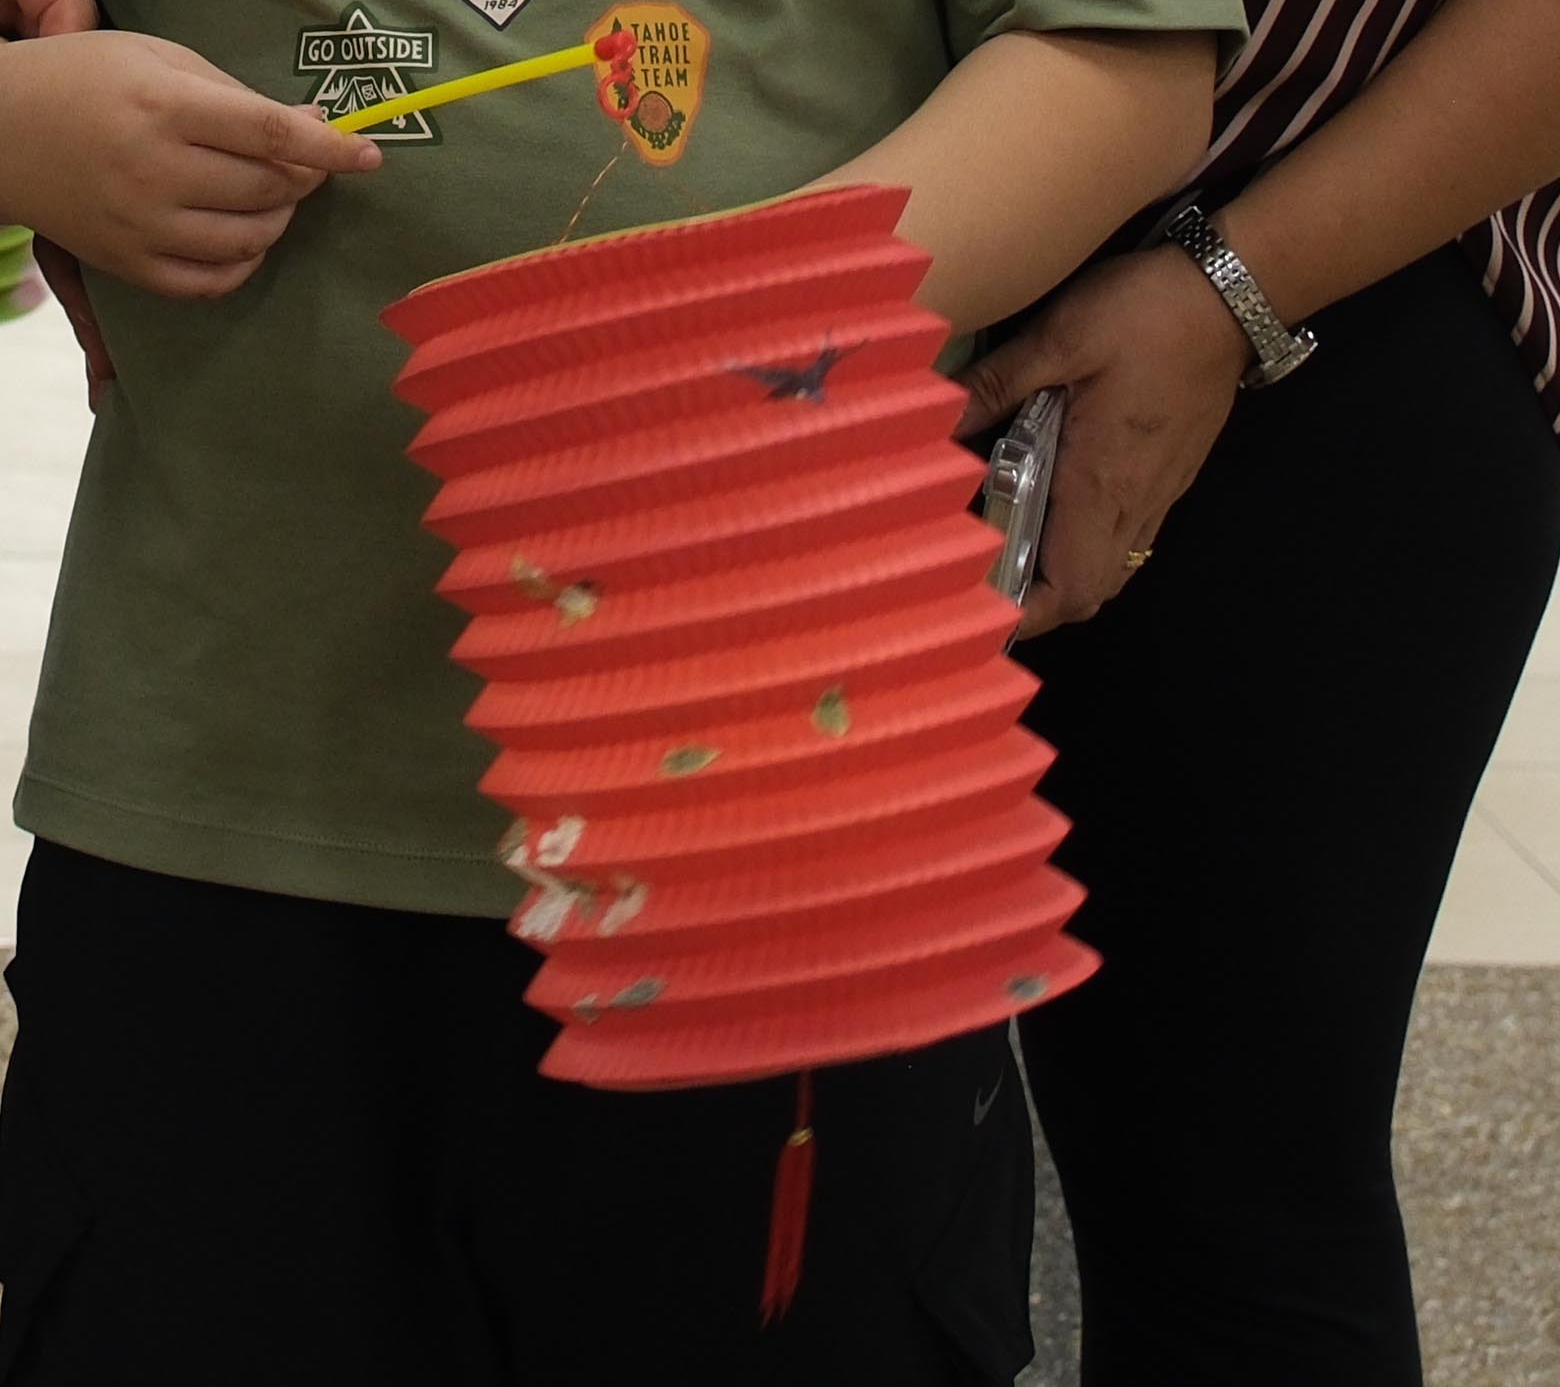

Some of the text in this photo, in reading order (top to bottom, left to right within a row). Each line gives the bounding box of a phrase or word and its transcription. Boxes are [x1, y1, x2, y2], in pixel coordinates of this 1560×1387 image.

[631, 22, 691, 42] TAHOE
[308, 36, 423, 62] GO OUTSIDE
[638, 45, 691, 64] TRAIL
[641, 68, 689, 87] TEAM
